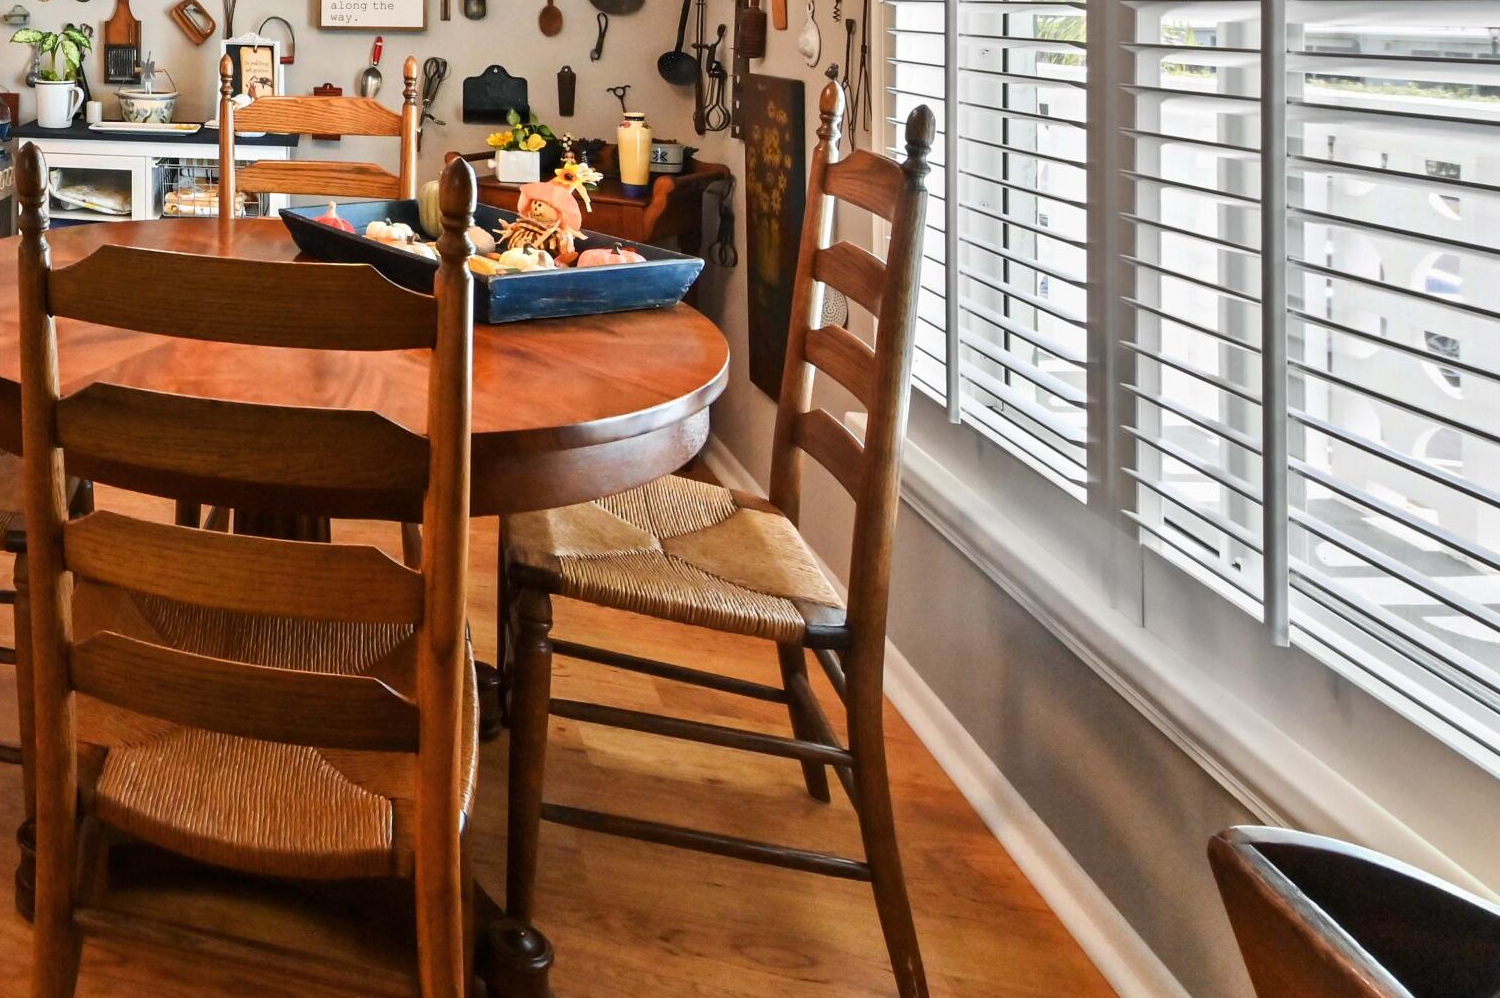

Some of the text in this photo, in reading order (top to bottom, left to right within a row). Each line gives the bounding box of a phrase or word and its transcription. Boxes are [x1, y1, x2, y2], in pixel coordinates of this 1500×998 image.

[330, 1, 395, 12] along the
[330, 13, 358, 23] way.
